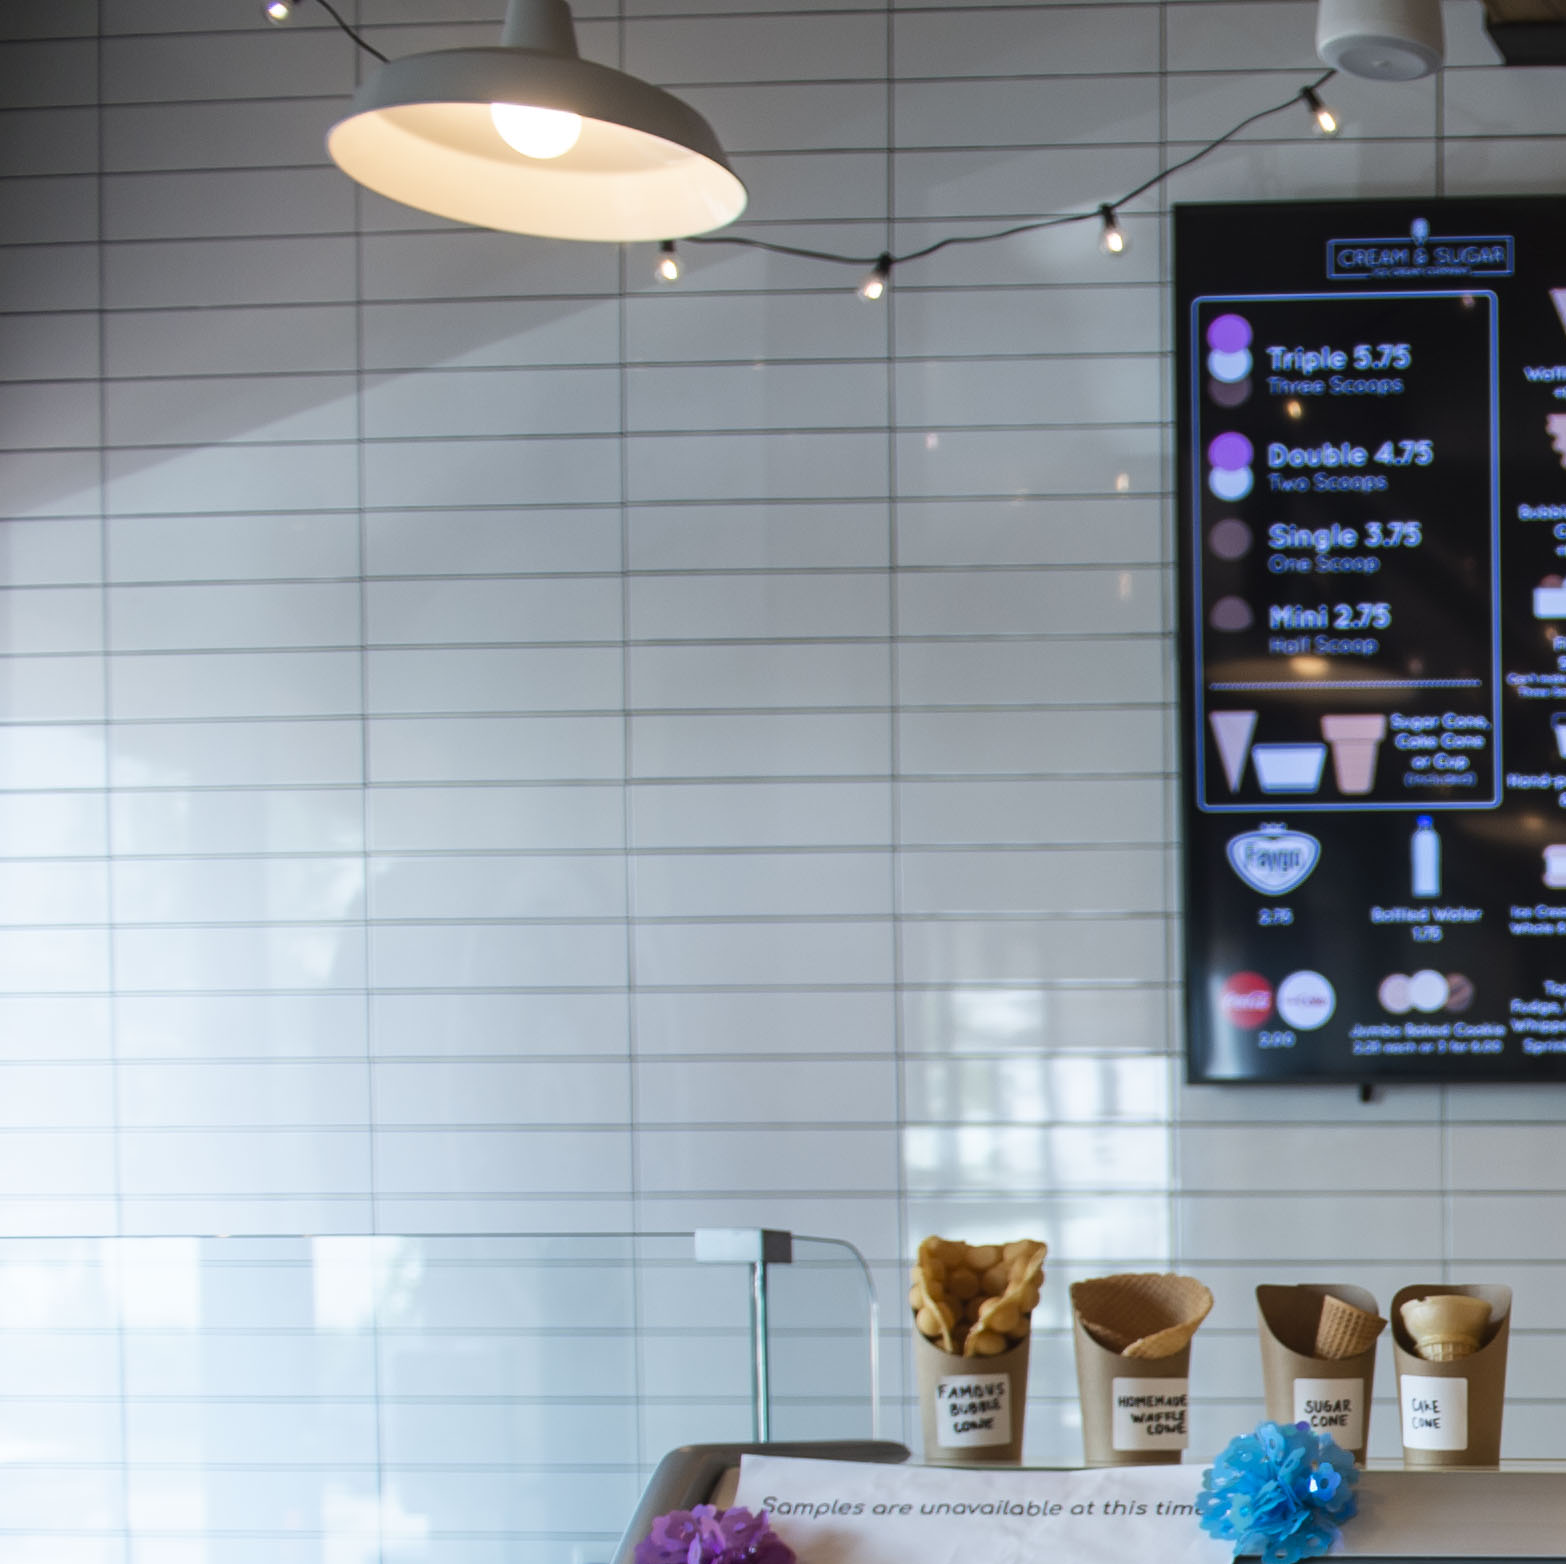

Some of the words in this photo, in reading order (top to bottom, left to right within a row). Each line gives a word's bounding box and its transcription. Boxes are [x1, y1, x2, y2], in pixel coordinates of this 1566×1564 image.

[1266, 346, 1347, 374] Triple
[1354, 344, 1410, 369] 5.75
[1268, 442, 1368, 467] Double
[1374, 440, 1433, 465] 4.75
[1269, 524, 1357, 553] Single
[1365, 521, 1421, 547] 3.75
[1270, 605, 1328, 628] Mini
[1334, 603, 1390, 629] 2.75
[1304, 1399, 1351, 1414] SUGAR
[1412, 1398, 1441, 1413] CAKE
[1131, 1410, 1186, 1424] WAFFLE
[1311, 1415, 1348, 1427] CONE
[1412, 1417, 1441, 1429] CONE
[757, 1496, 865, 1519] Samples
[872, 1504, 913, 1515] are
[920, 1500, 1063, 1517] unavailable
[1070, 1502, 1095, 1515] at
[1103, 1500, 1147, 1515] this
